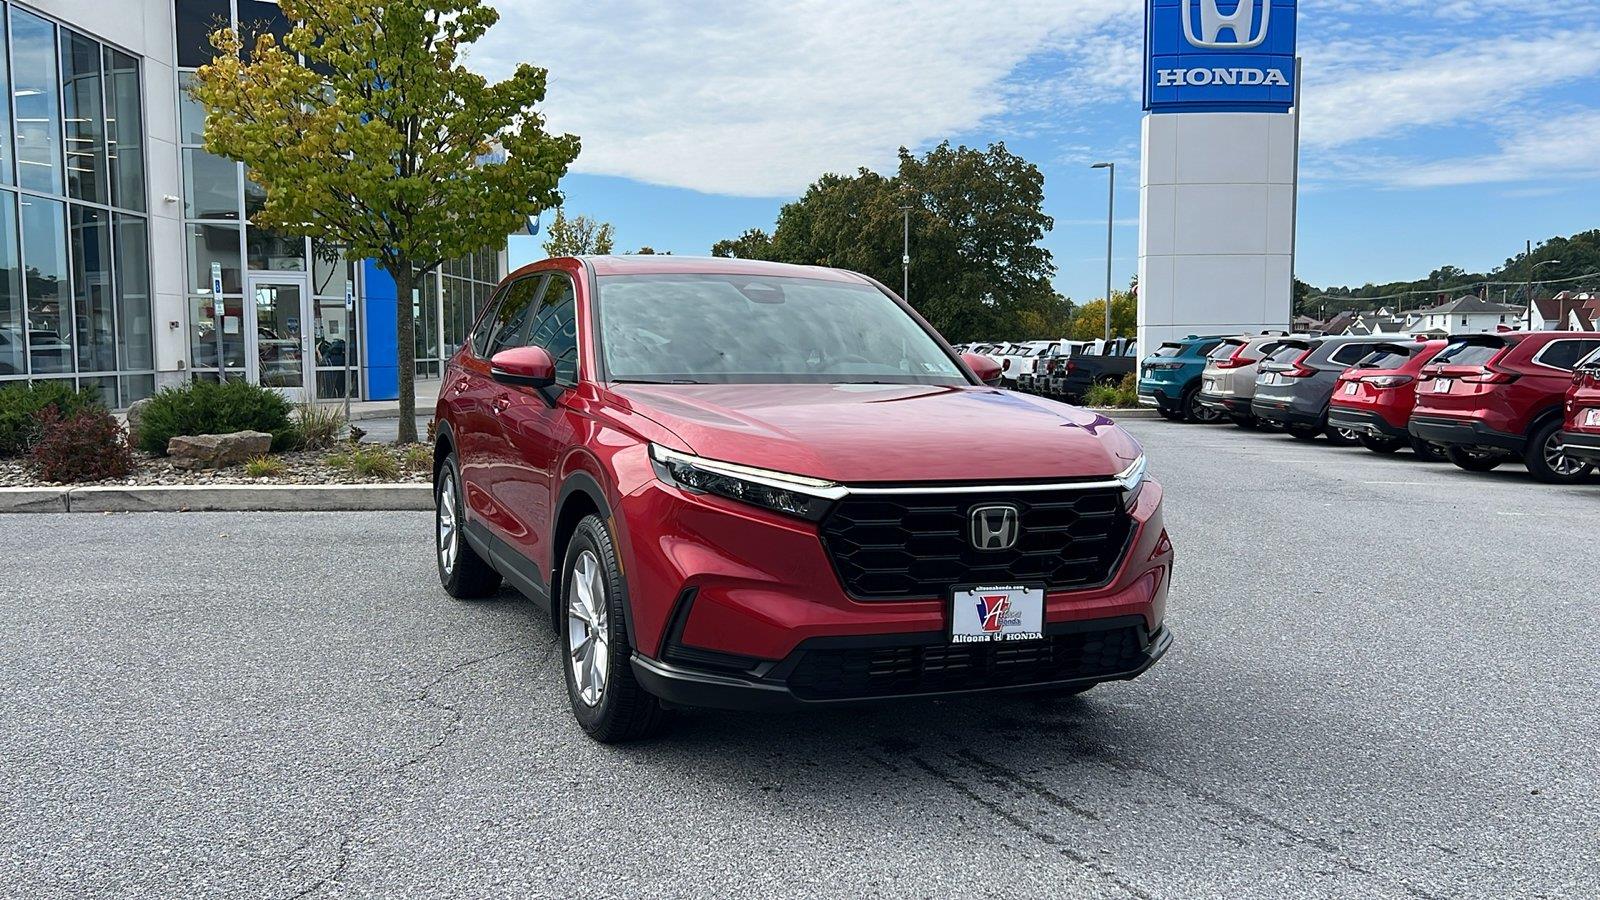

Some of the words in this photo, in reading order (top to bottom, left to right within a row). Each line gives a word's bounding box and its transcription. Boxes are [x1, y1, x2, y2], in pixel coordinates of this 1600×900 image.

[1156, 68, 1290, 86] HONDA
[952, 634, 991, 643] Altoona
[1006, 632, 1043, 641] HONDA
